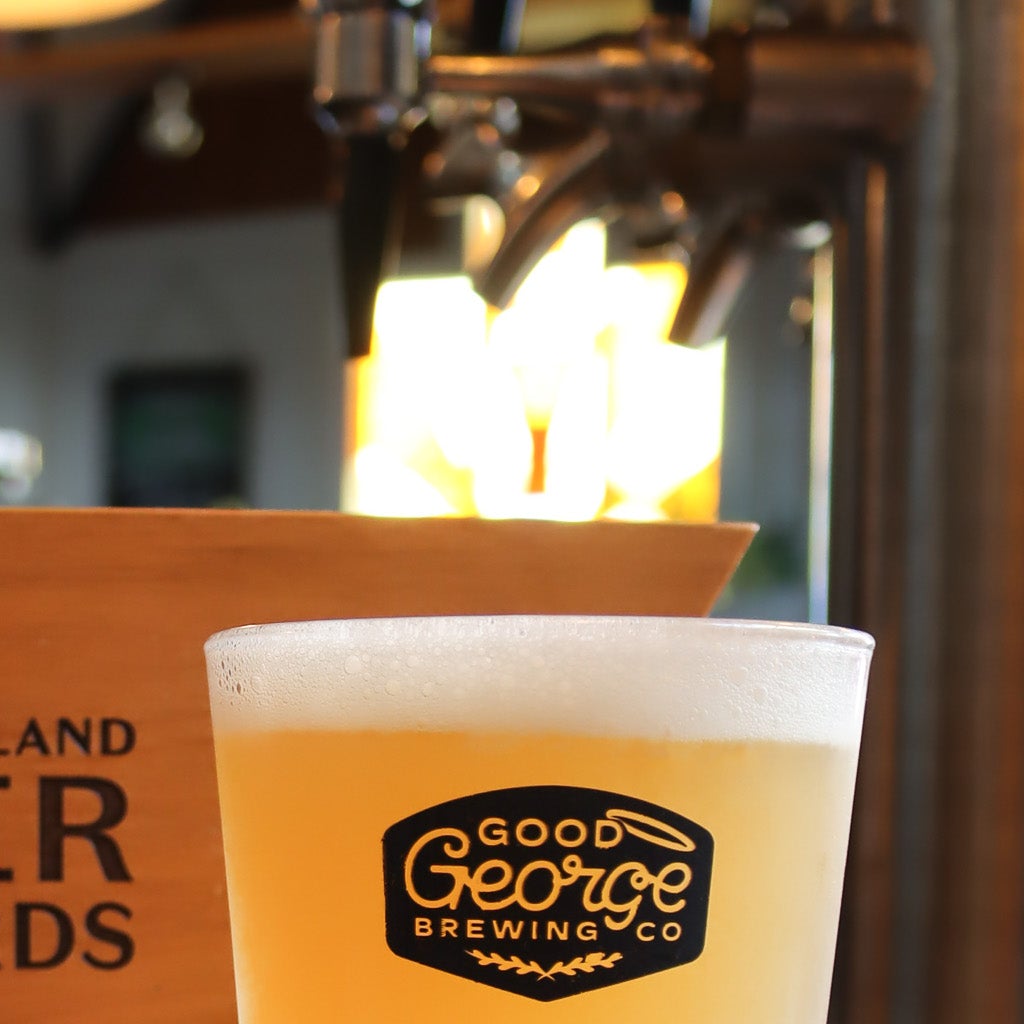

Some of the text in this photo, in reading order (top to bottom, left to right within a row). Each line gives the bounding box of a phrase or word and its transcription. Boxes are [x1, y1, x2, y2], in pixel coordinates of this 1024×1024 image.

[478, 817, 624, 849] GOOD
[404, 827, 692, 930] George
[414, 917, 682, 942] BREWING CO
